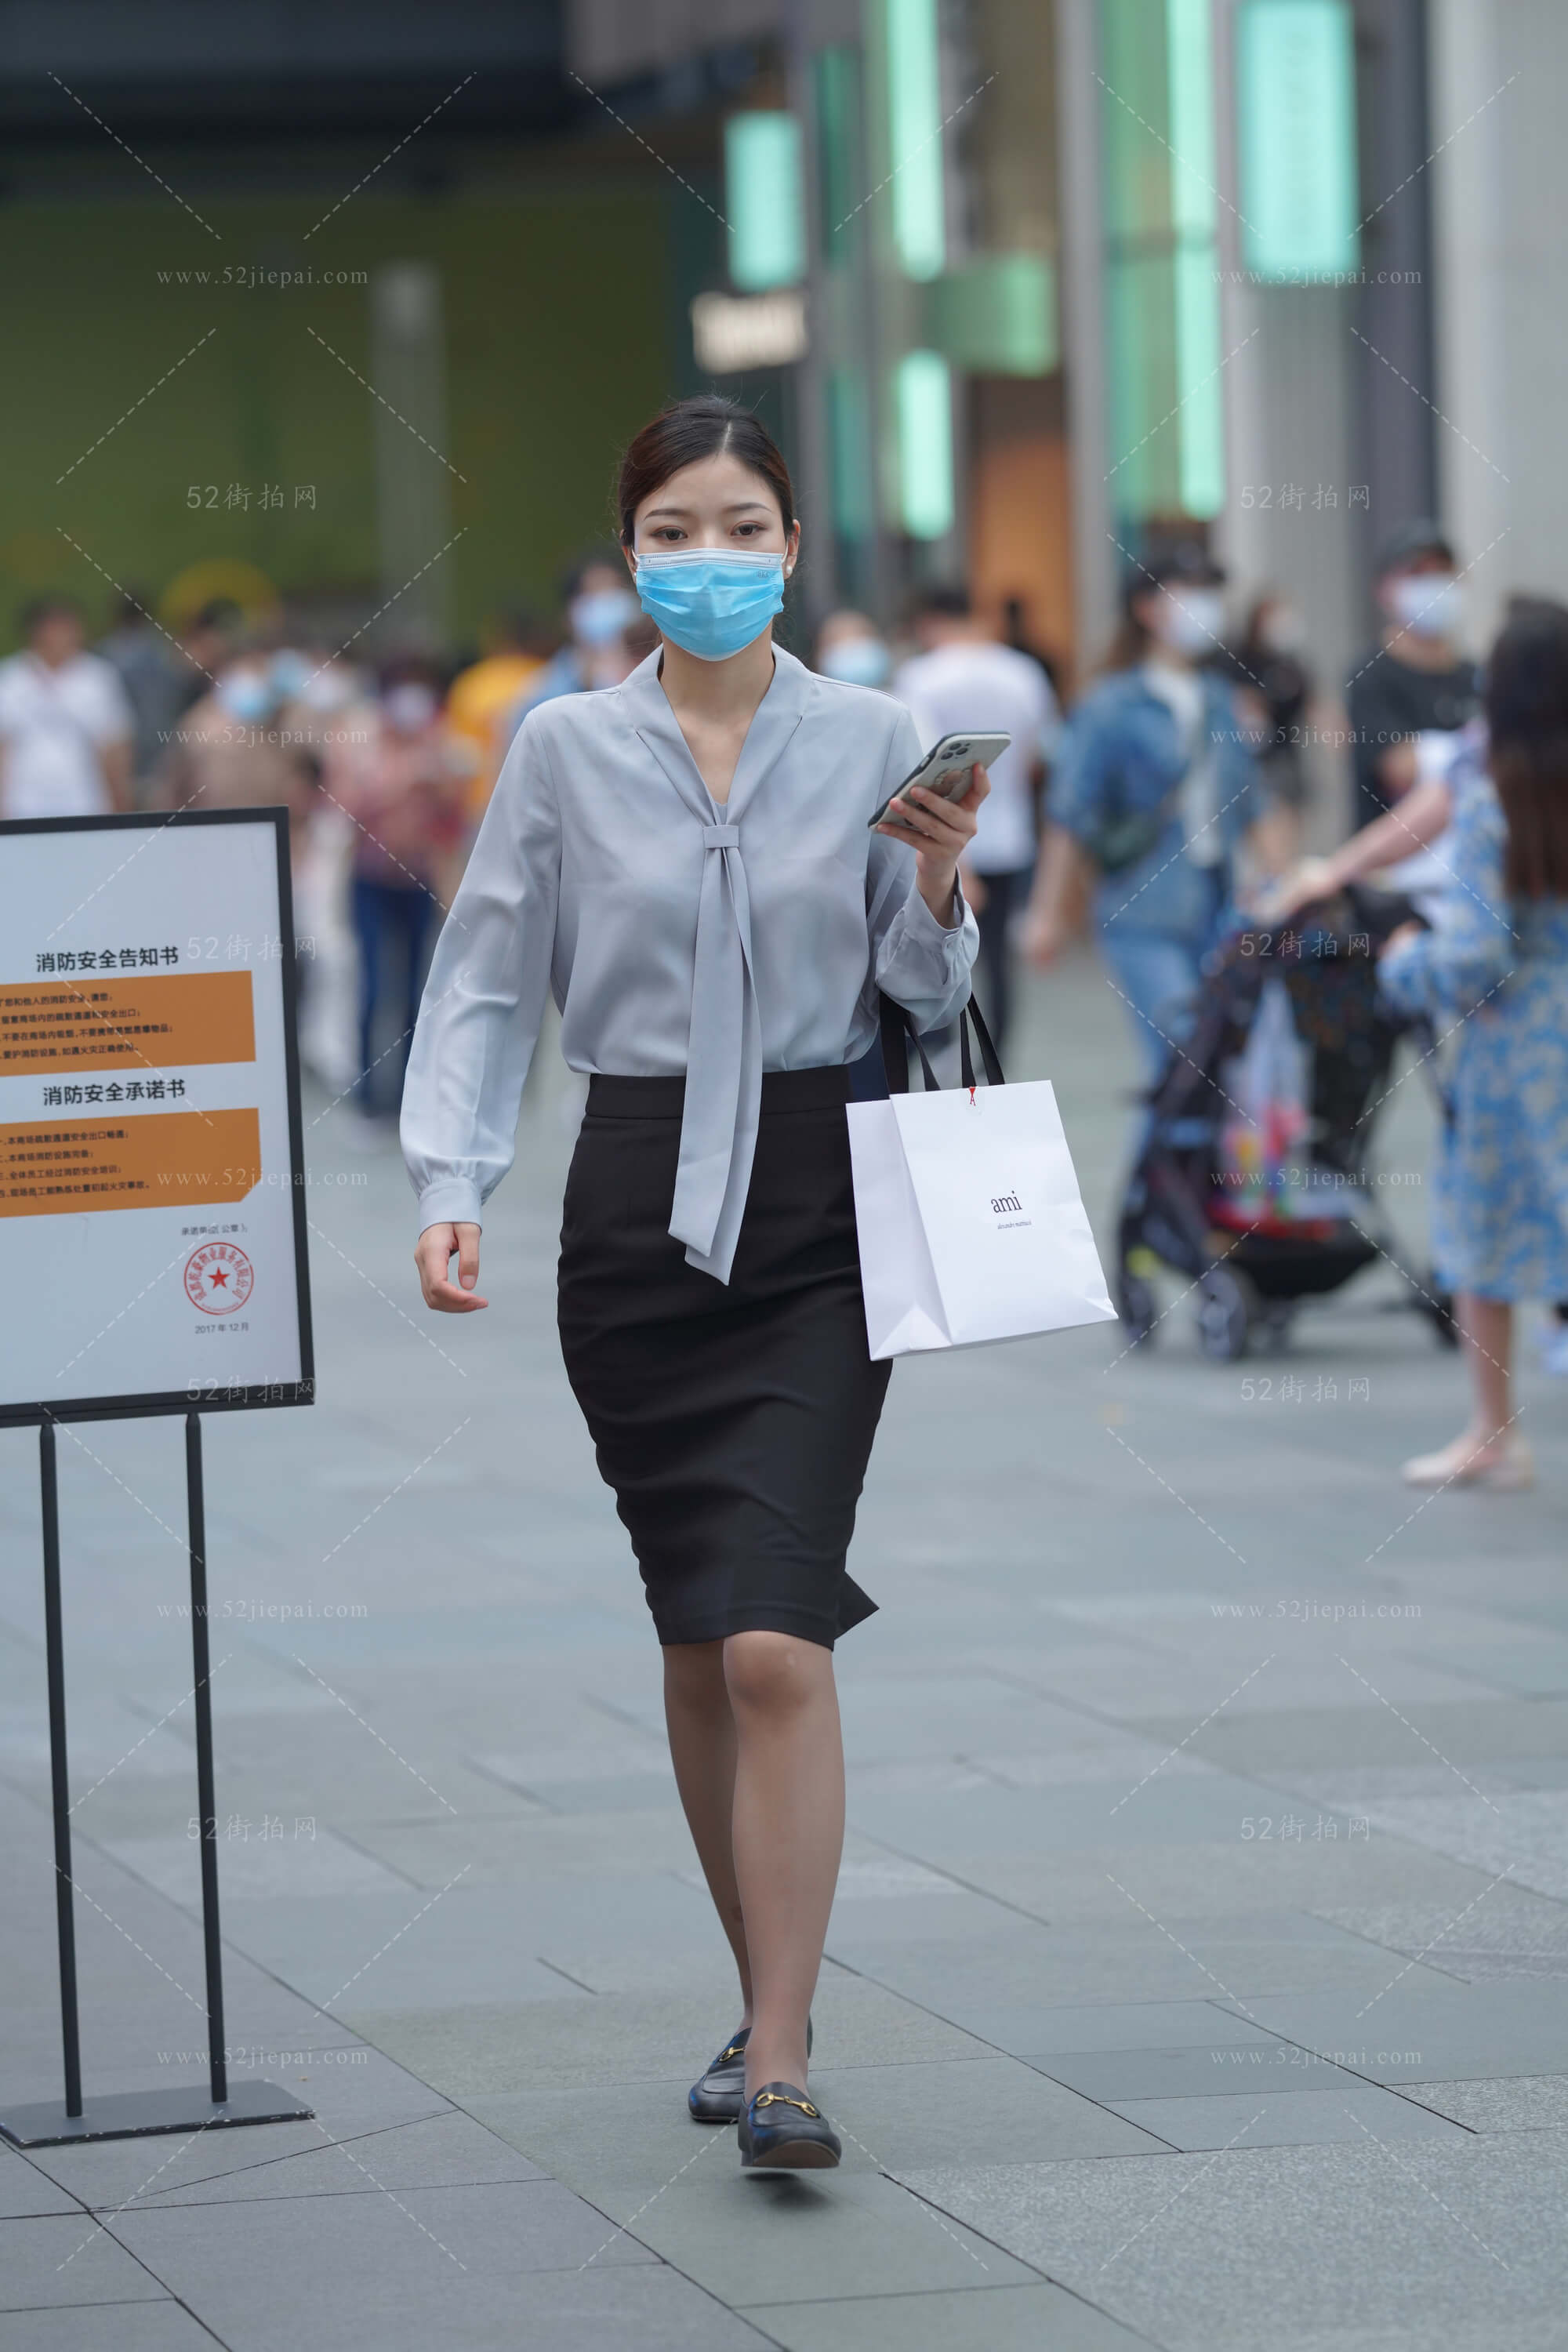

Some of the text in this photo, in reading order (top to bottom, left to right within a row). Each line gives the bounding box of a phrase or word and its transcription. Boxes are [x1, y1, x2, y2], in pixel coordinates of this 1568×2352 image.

[36, 946, 179, 973] 消防安全告知书
[43, 1079, 186, 1106] 消防安全承诺书
[992, 1190, 1022, 1213] ami
